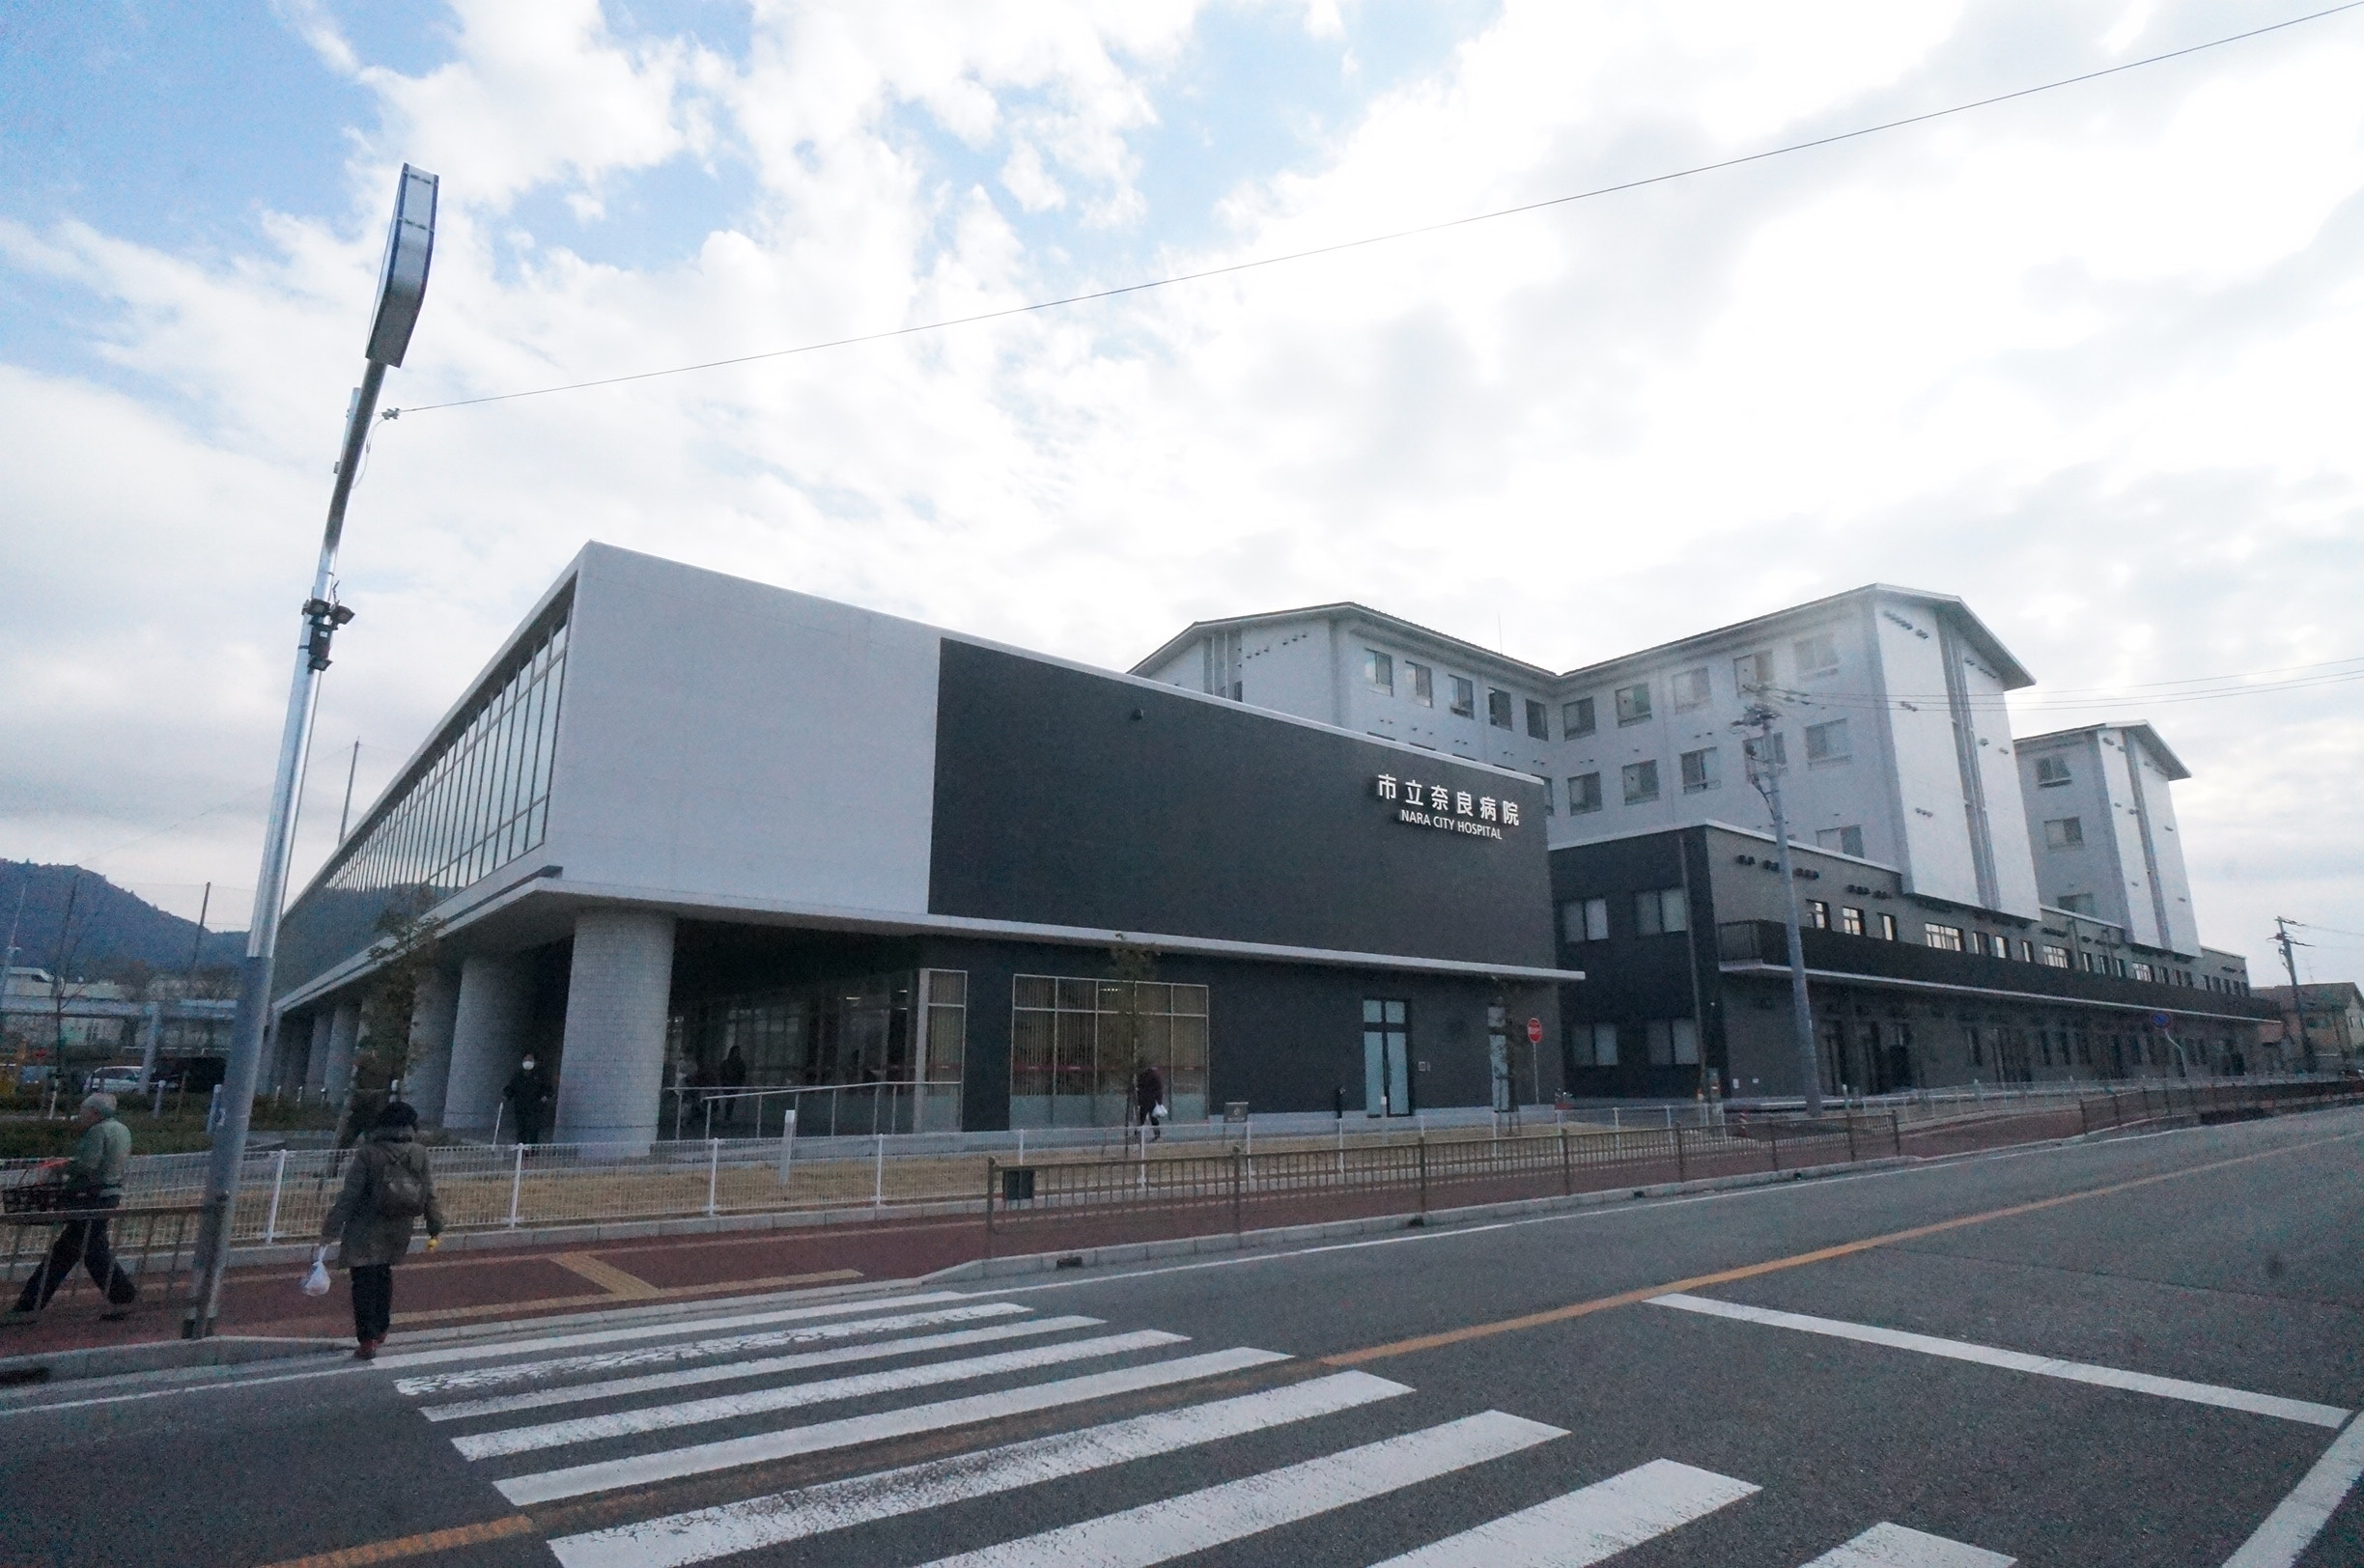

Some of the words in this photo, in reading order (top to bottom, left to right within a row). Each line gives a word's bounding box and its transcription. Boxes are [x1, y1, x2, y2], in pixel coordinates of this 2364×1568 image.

[1378, 773, 1519, 826] 市立奈良病院
[1401, 809, 1431, 826] NARA
[1433, 816, 1454, 830] CITY
[1457, 821, 1503, 840] HOSPITAL
